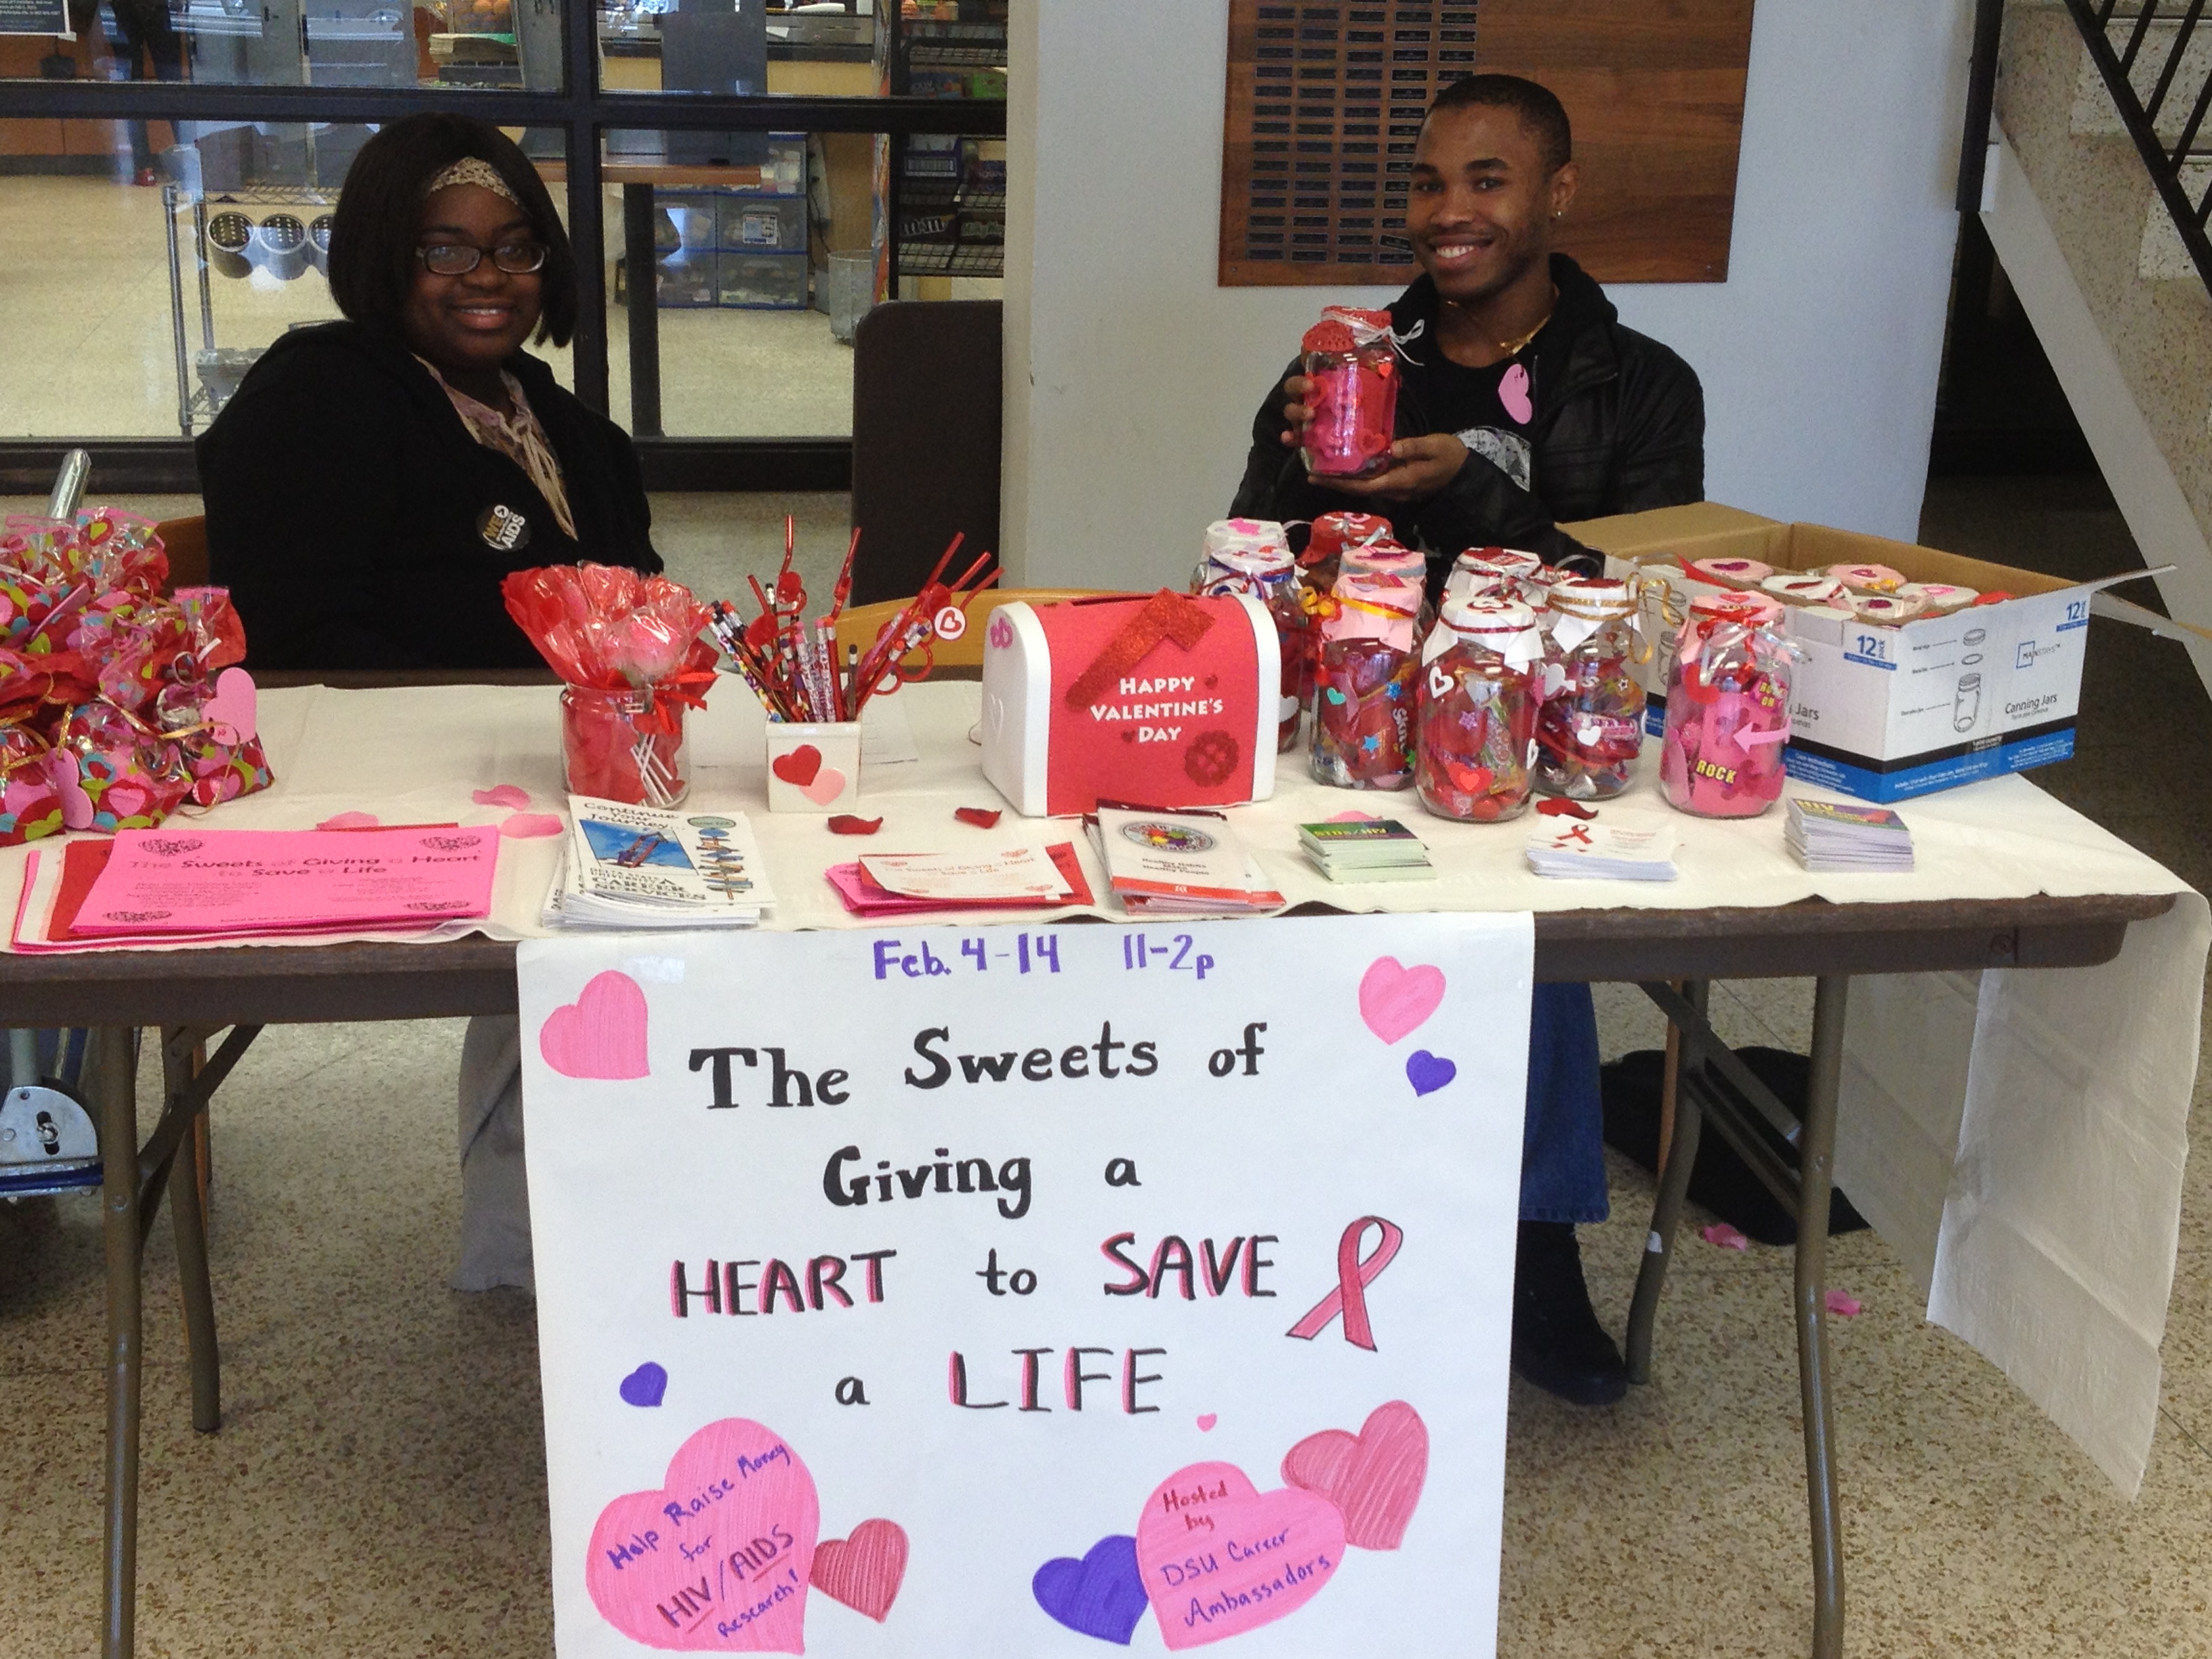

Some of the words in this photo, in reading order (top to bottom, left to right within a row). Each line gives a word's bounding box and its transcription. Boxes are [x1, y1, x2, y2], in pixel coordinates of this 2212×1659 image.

[501, 514, 526, 549] AIDS
[2066, 601, 2081, 621] 12
[1856, 634, 1877, 657] 12
[1120, 676, 1195, 695] HAPPY
[1090, 698, 1224, 722] VALENTINE'S
[1795, 703, 1820, 721] Jars
[2005, 698, 2039, 714] Canning
[2041, 694, 2057, 706] Jars
[1139, 726, 1181, 743] DAY
[1696, 759, 1738, 784] ROCK
[584, 801, 678, 819] Continue
[181, 859, 263, 868] Sweets
[304, 857, 380, 866] Giving
[411, 855, 481, 864] Heart
[252, 867, 310, 876] Save
[343, 866, 387, 874] Life
[874, 939, 952, 979] Feb.
[1124, 933, 1214, 980] 11-2p
[689, 1046, 851, 1110] The
[904, 1020, 1159, 1090] Sweets
[1208, 1022, 1267, 1078] of
[823, 1145, 1032, 1220] Giving
[1104, 1158, 1143, 1187] a
[670, 1249, 897, 1318] HEART
[975, 1248, 1038, 1296] to
[1100, 1231, 1279, 1301] SAVE
[834, 1376, 871, 1406] a
[949, 1347, 1167, 1415] LIFE
[605, 1530, 661, 1572] Help
[662, 1477, 735, 1527] Raise
[736, 1443, 792, 1479] Money
[1163, 1480, 1228, 1513] Hosted
[1184, 1513, 1215, 1532] by
[680, 1535, 713, 1562] for
[1160, 1555, 1219, 1587] DSU
[1227, 1528, 1291, 1563] Career
[655, 1524, 796, 1629] HIV/AIDS
[716, 1568, 802, 1638] Research!
[1183, 1555, 1332, 1629] Ambassadors
